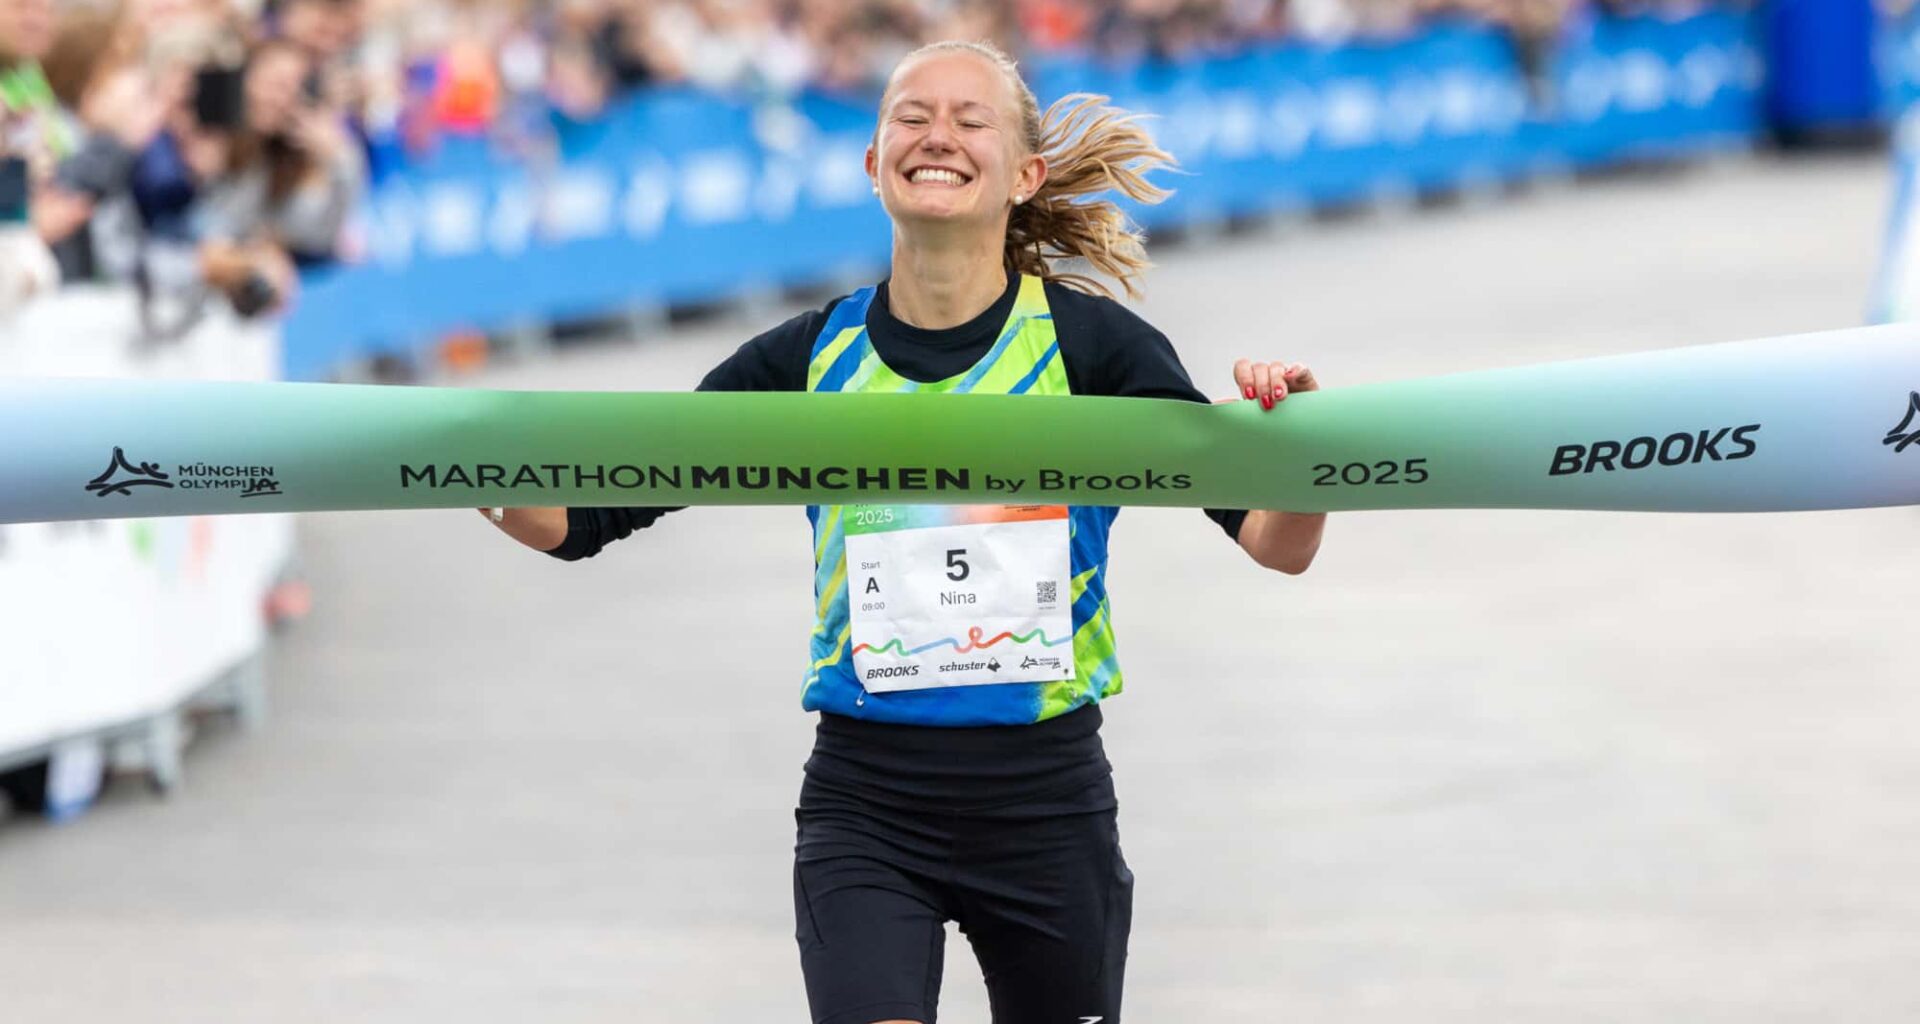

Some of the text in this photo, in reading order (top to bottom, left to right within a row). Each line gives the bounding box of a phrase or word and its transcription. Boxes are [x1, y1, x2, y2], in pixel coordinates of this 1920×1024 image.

[1548, 423, 1761, 476] BROOKS
[178, 462, 275, 478] MÜNCHEN
[985, 474, 1026, 494] by
[1039, 468, 1192, 491] Brooks
[1312, 458, 1429, 486] 2025
[855, 508, 894, 526] 2025
[860, 560, 881, 570] Start
[946, 548, 970, 582] 5
[865, 576, 880, 595] A
[861, 601, 885, 612] 09:00
[940, 591, 977, 606] Nina
[866, 664, 920, 680] BROOKS
[938, 660, 986, 673] schuster
